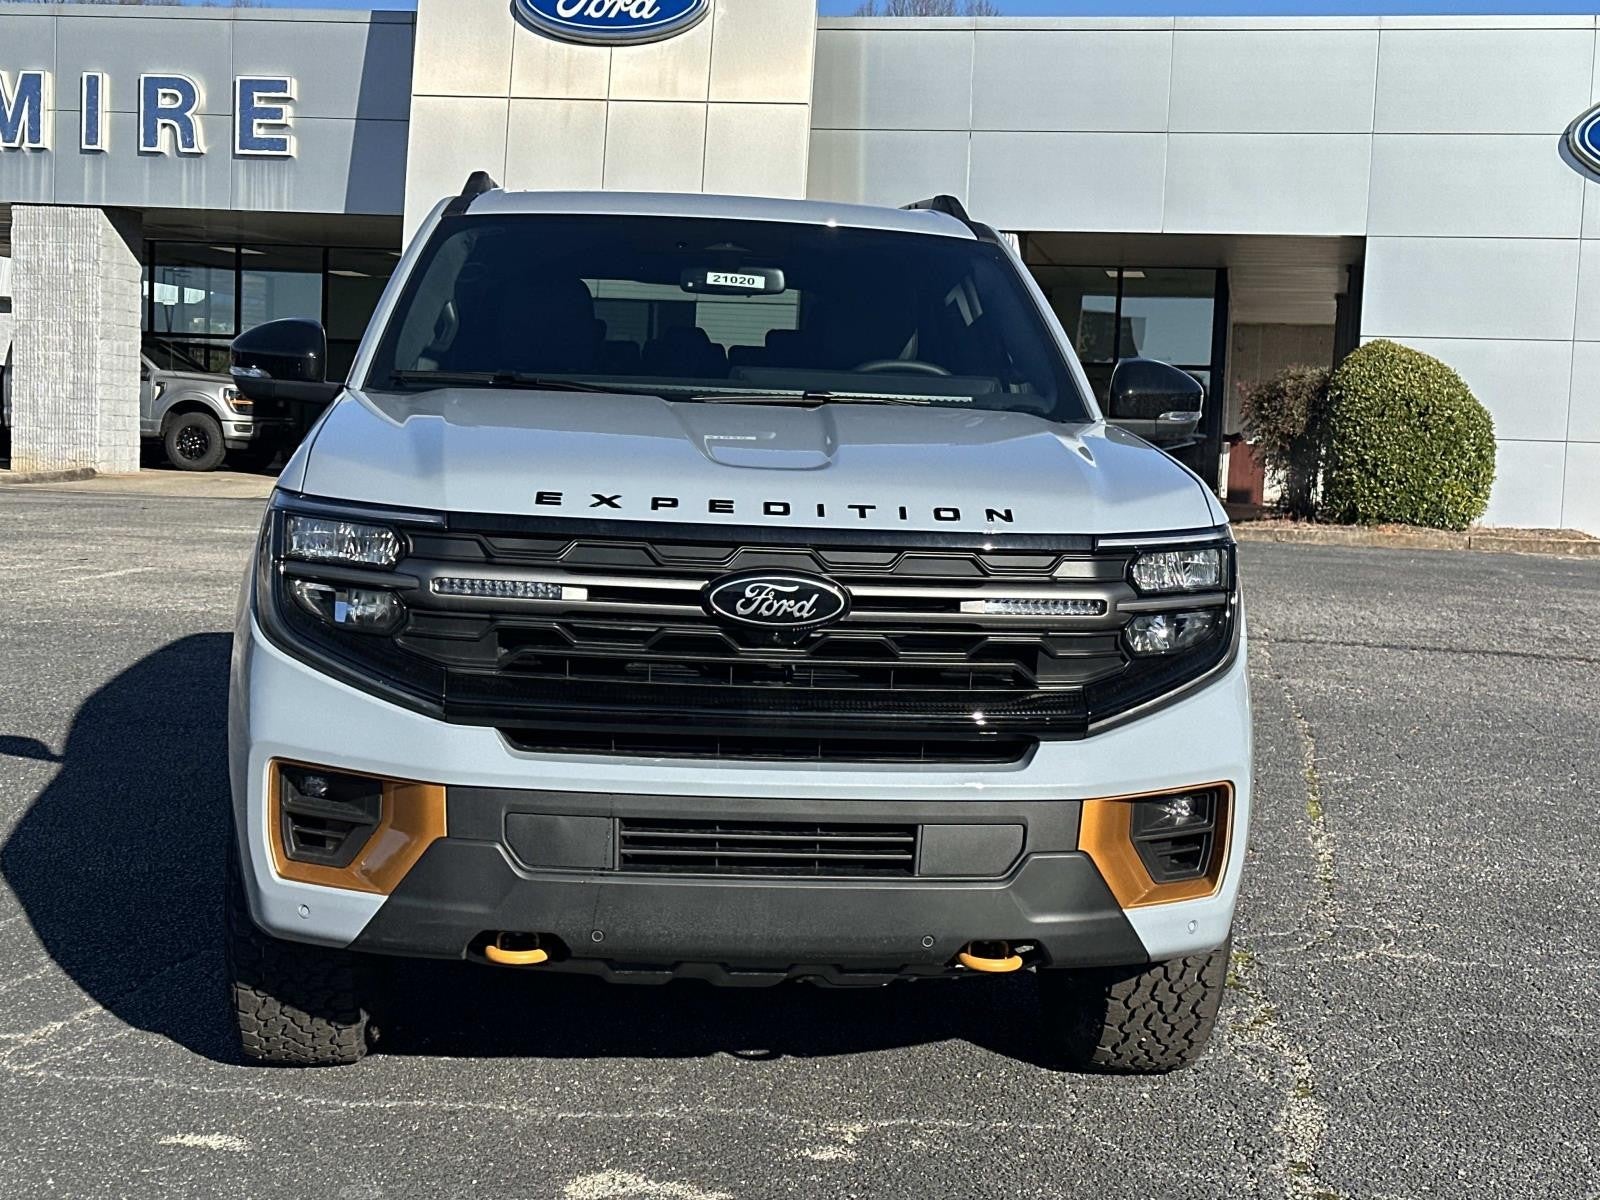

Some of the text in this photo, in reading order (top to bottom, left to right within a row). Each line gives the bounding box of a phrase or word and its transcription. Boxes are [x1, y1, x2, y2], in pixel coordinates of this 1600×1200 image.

[713, 275, 755, 285] 21020
[534, 490, 1015, 523] EXPEDITION
[735, 582, 818, 618] Ford
